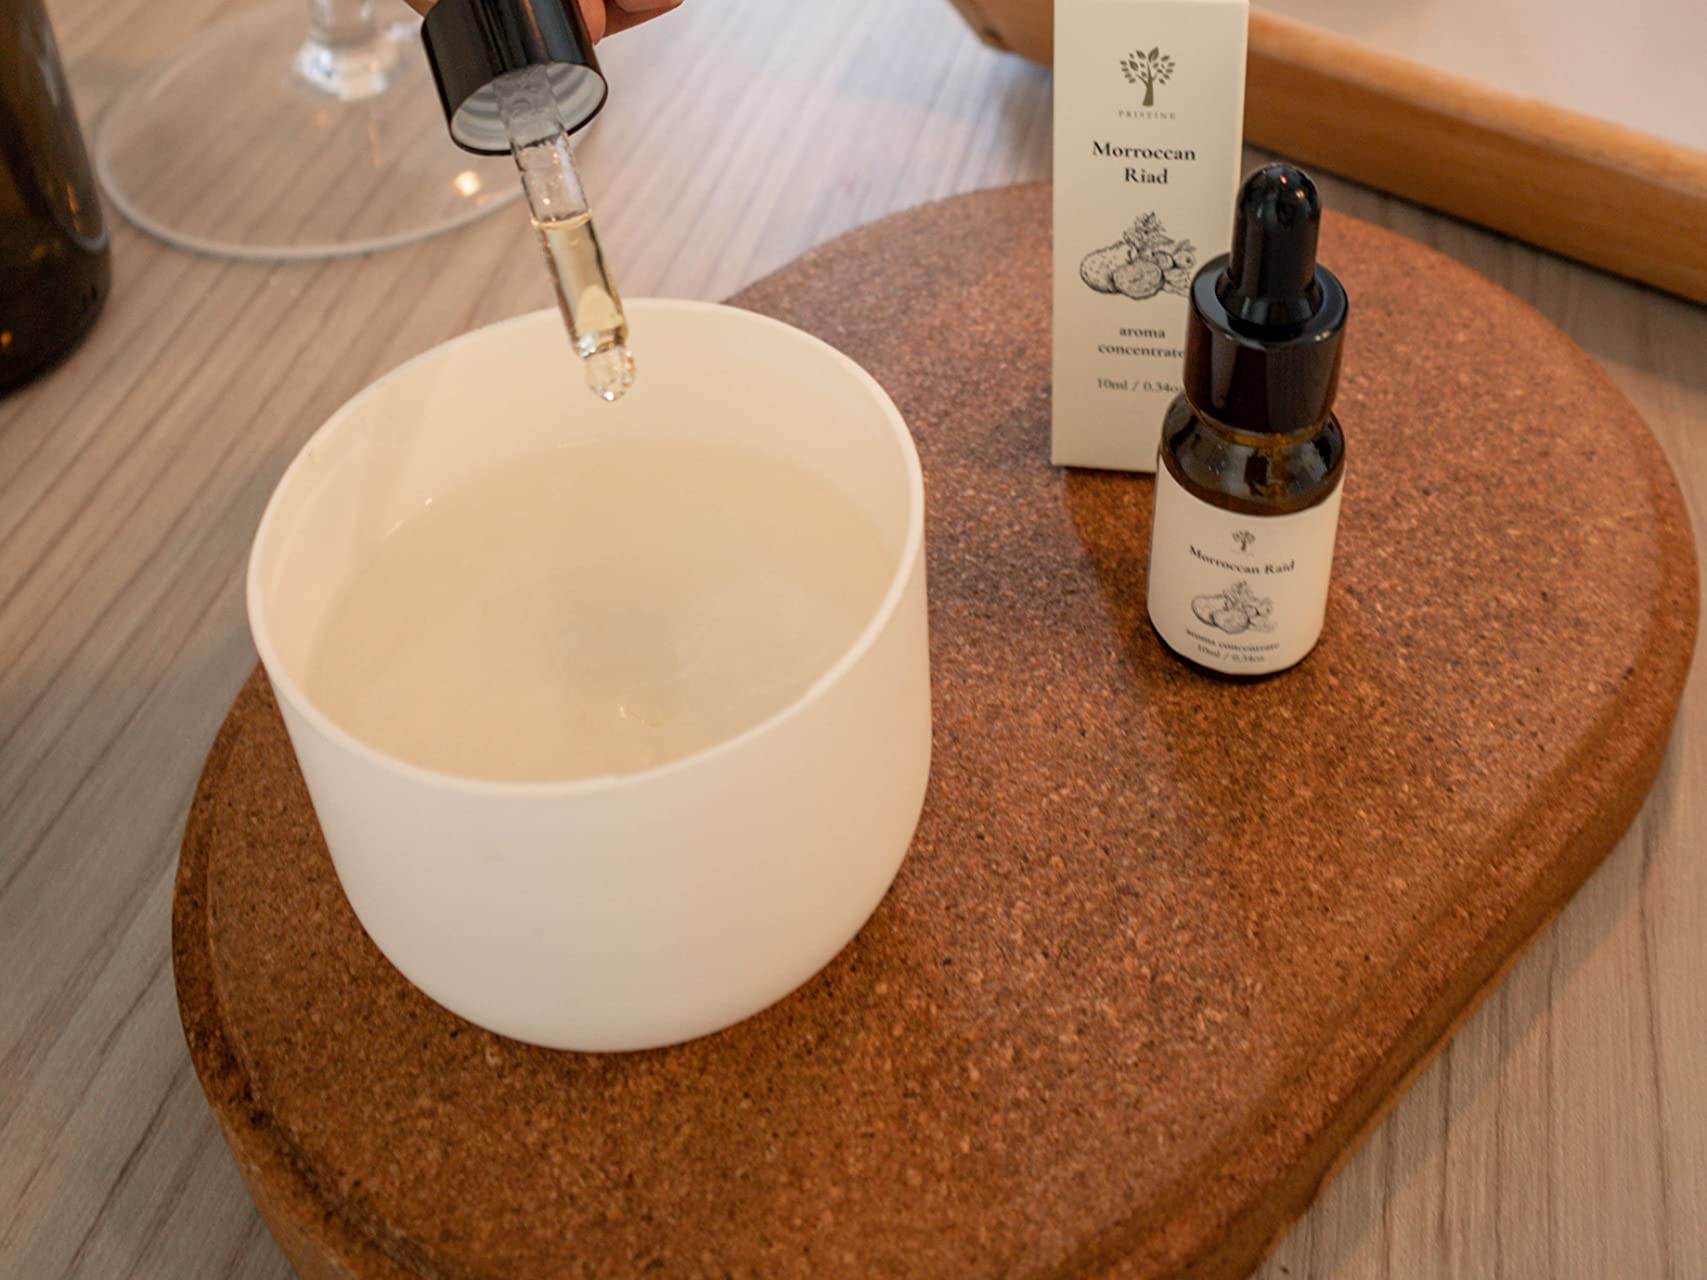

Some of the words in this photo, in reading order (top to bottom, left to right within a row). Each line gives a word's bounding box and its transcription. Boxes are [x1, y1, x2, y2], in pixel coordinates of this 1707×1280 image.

[1093, 140, 1196, 161] Morroccan
[1124, 168, 1169, 185] Riad
[1120, 327, 1165, 338] aroma
[1097, 378, 1128, 391] 10ml
[1189, 545, 1260, 574] Morroccan
[1264, 560, 1295, 574] Raid
